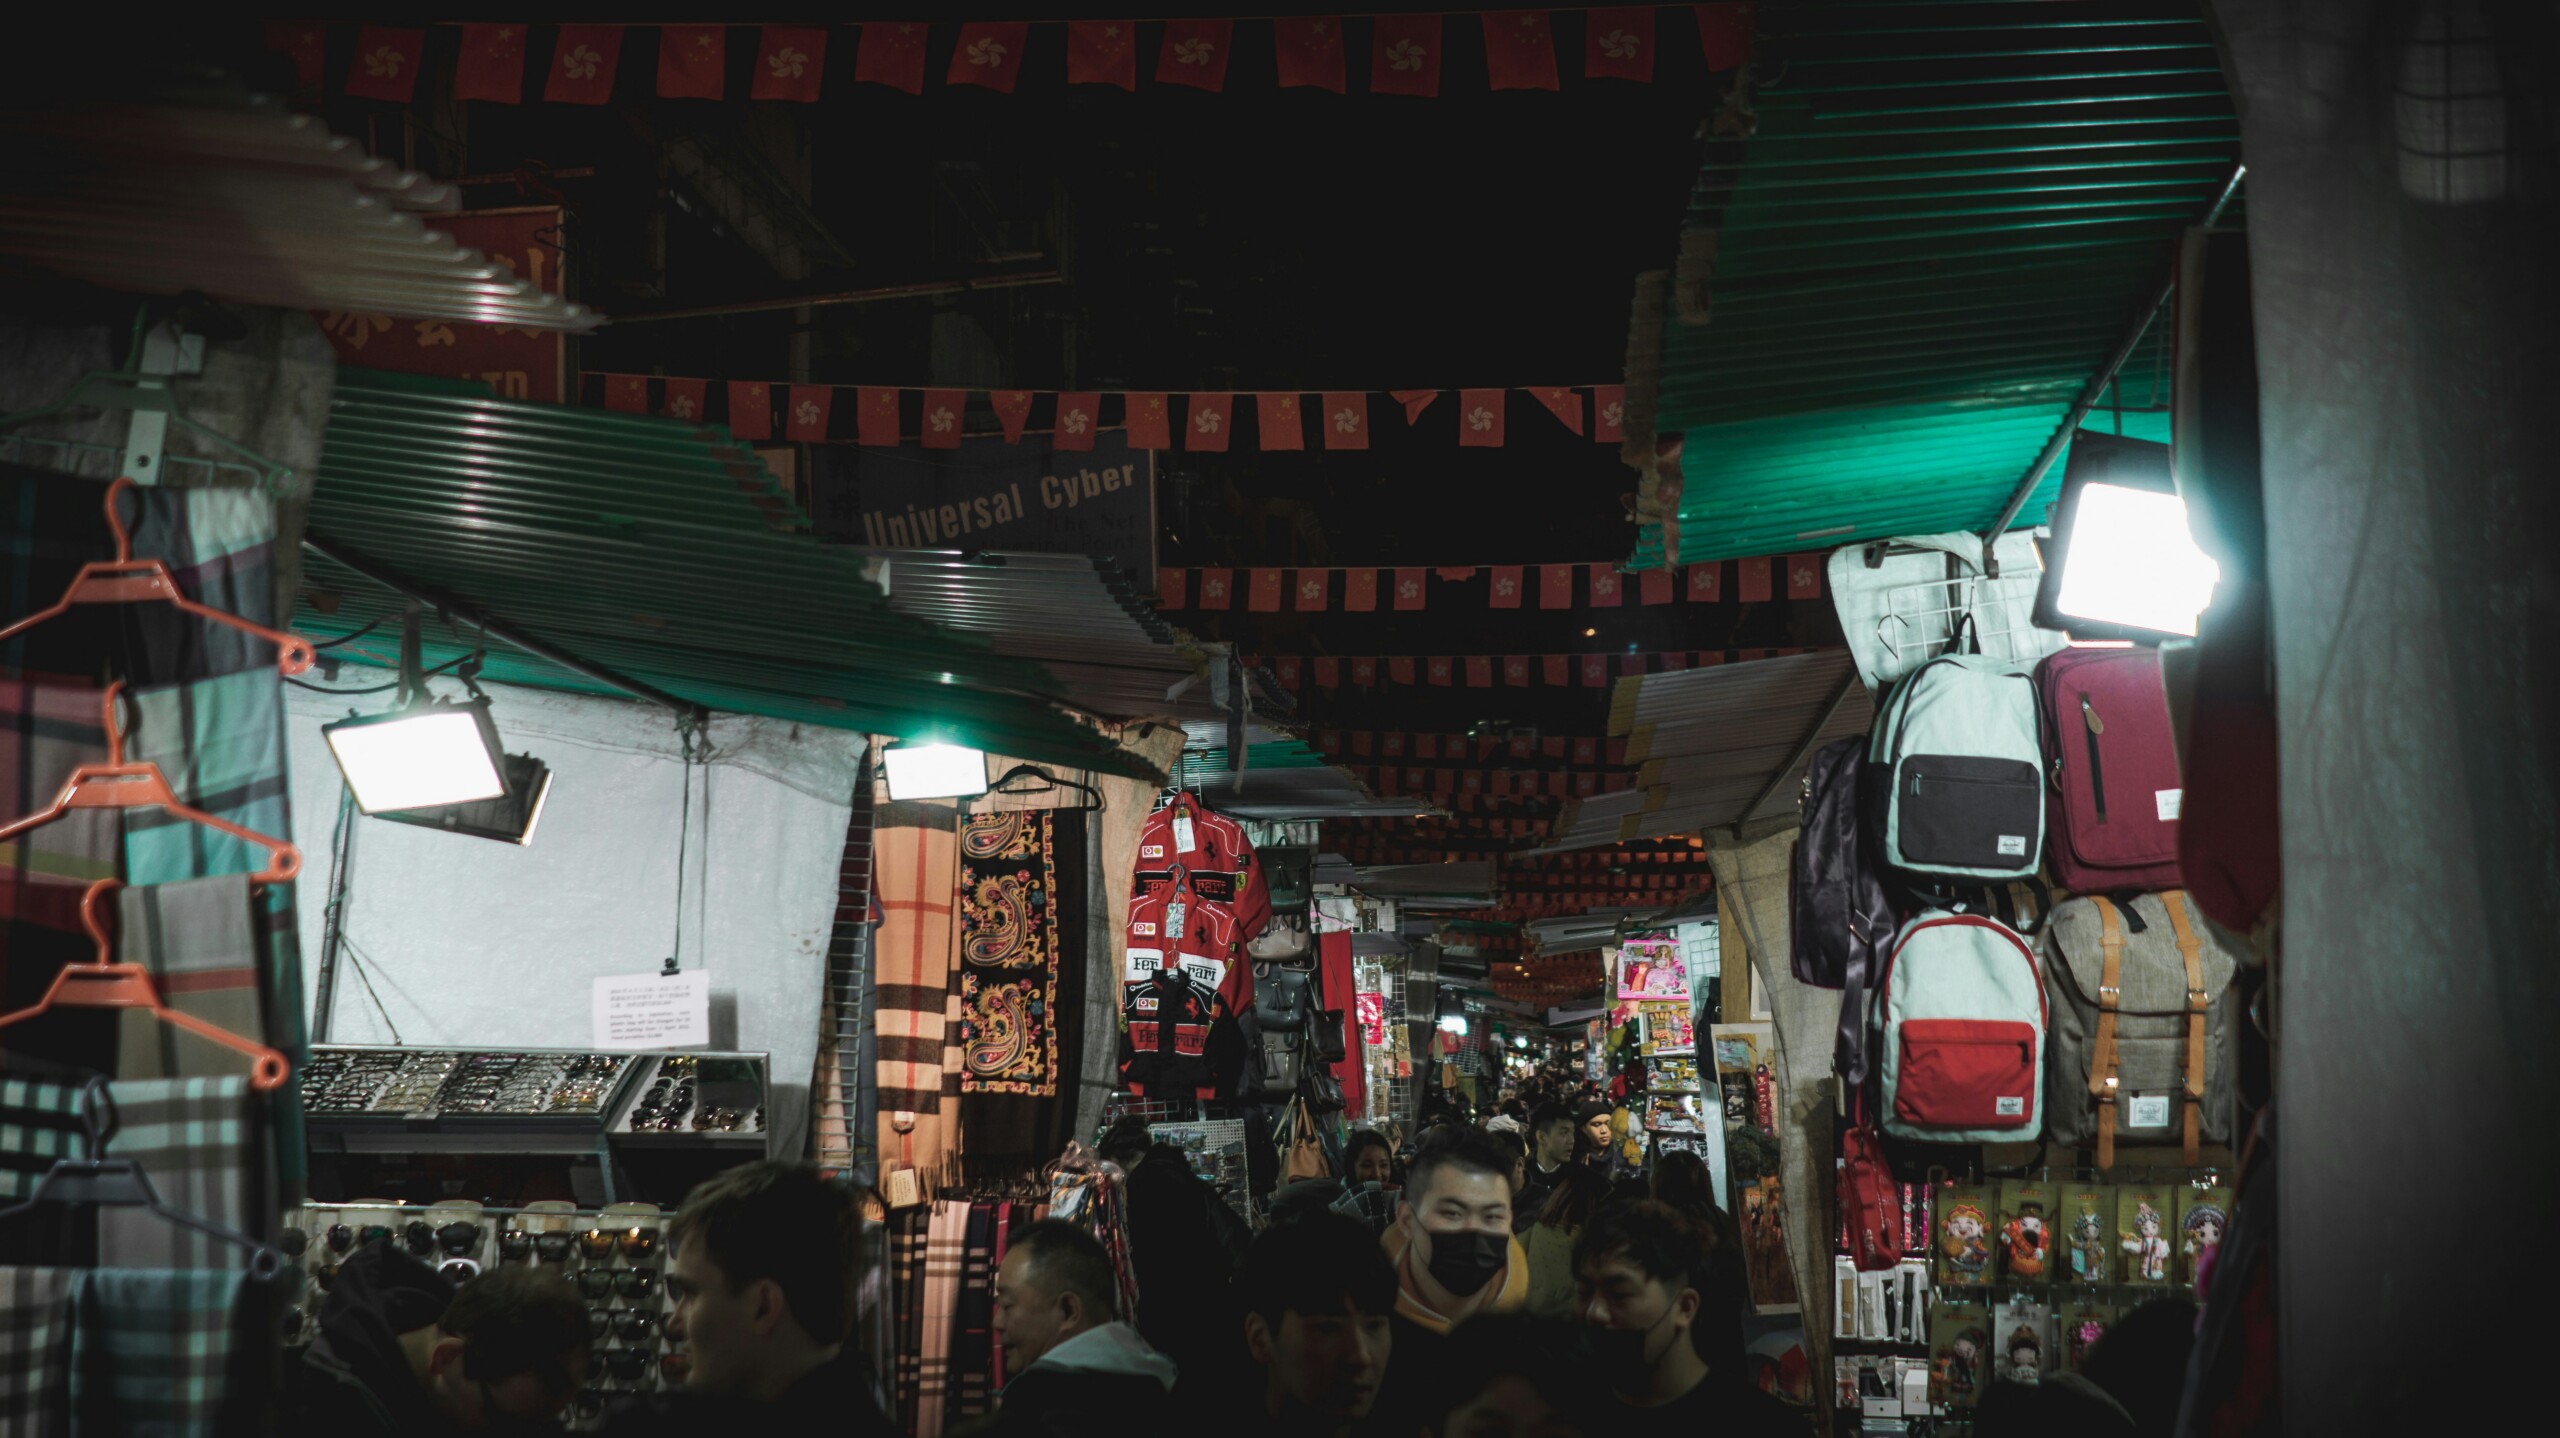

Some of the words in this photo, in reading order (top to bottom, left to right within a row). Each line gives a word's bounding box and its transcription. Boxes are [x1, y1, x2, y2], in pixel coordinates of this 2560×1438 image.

[863, 483, 1024, 546] Universal
[1039, 463, 1135, 509] Cyber
[1101, 512, 1135, 531] Net
[1082, 533, 1136, 550] Point
[1187, 963, 1217, 981] rari
